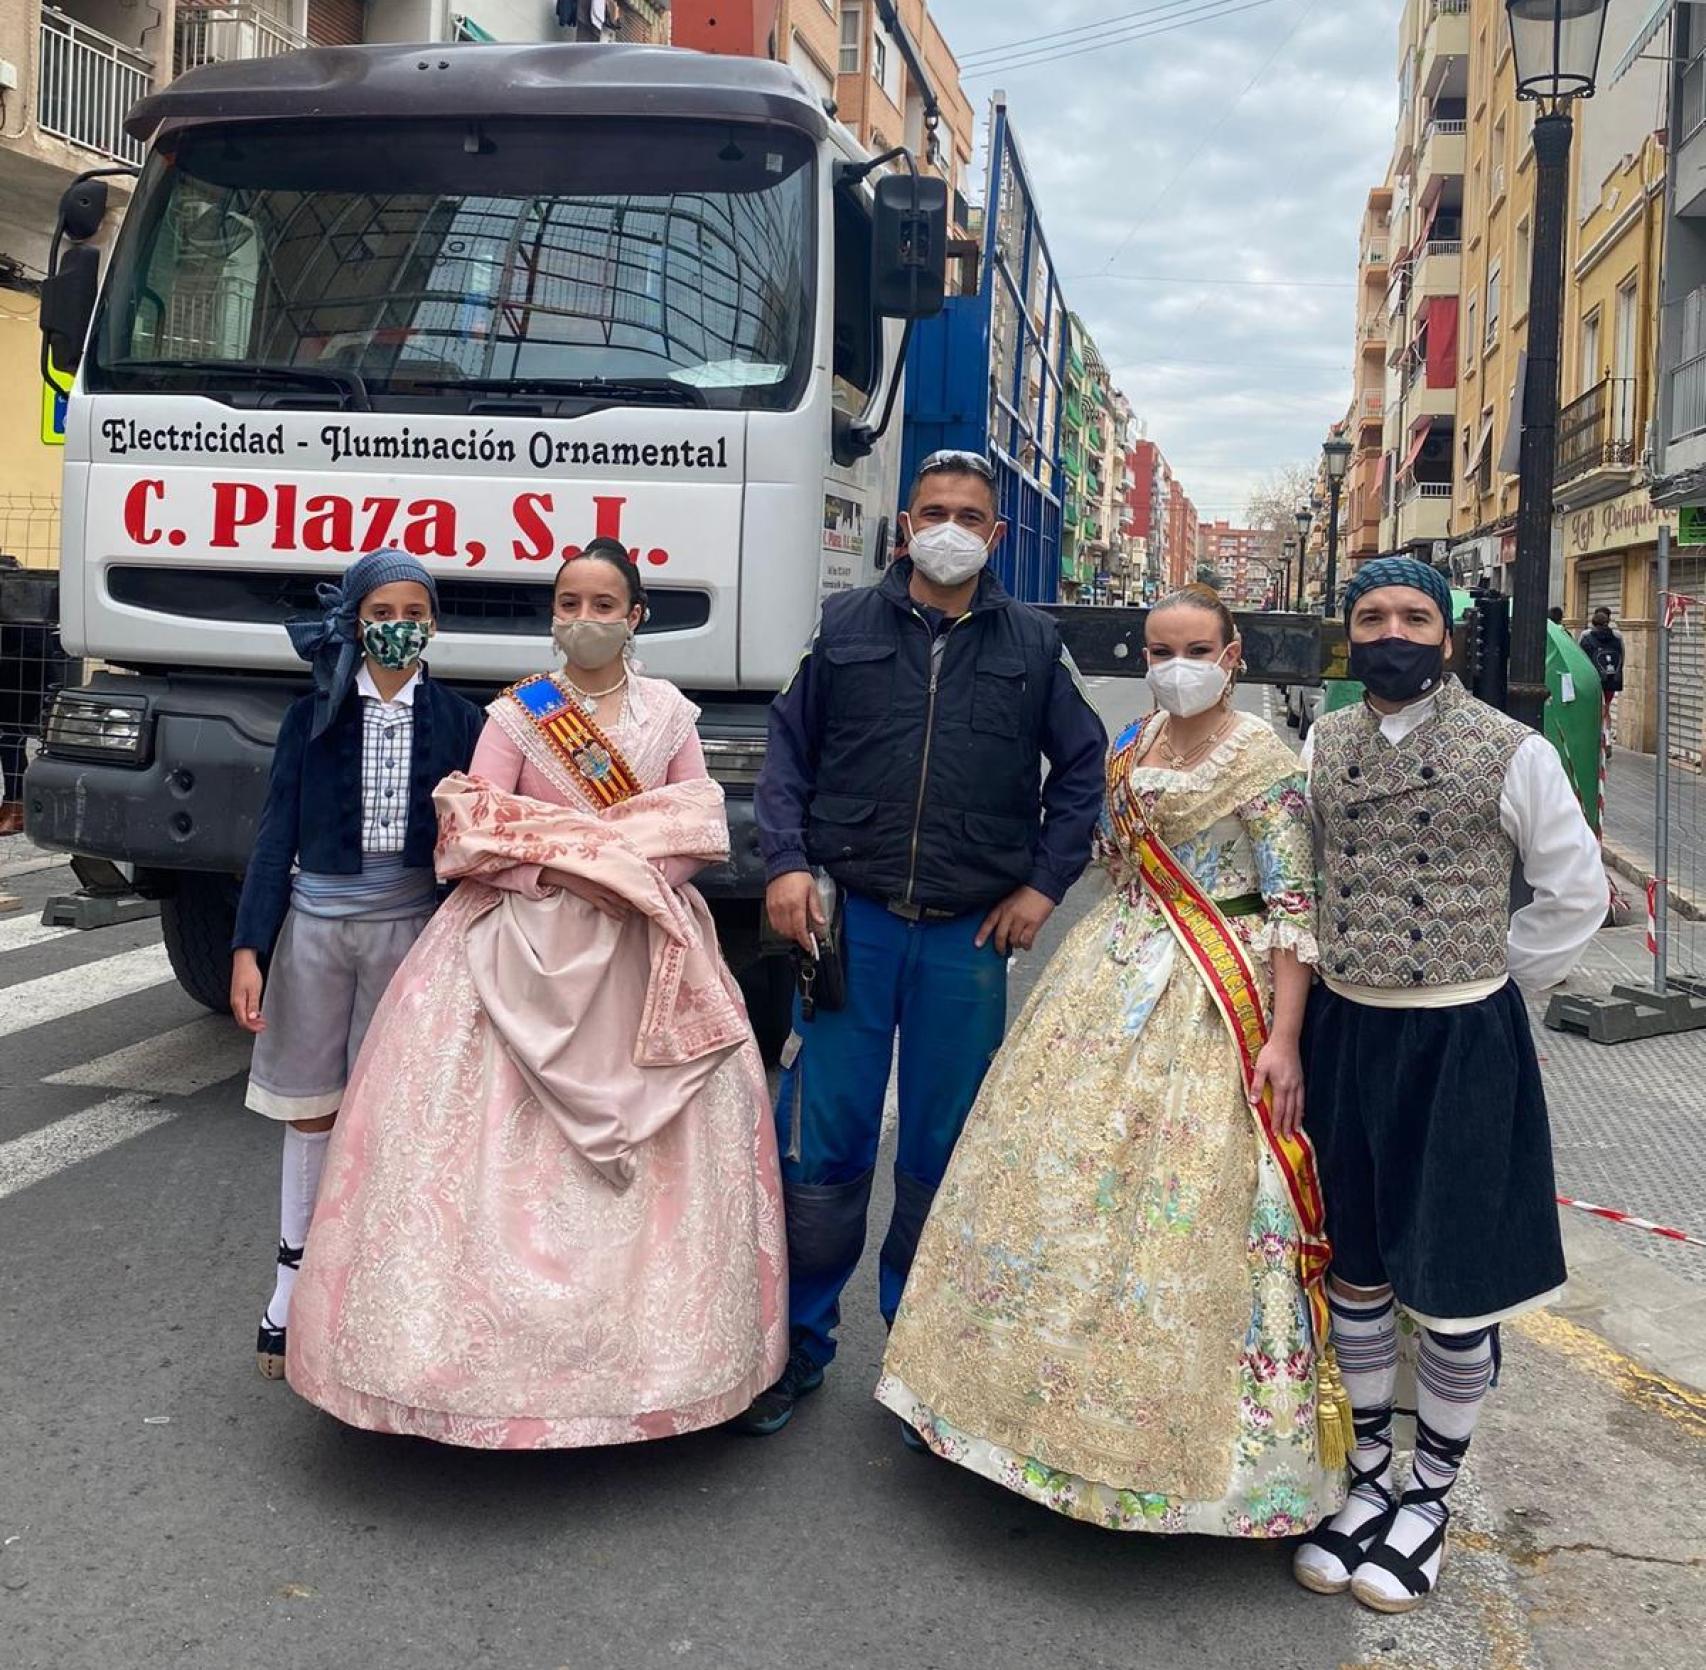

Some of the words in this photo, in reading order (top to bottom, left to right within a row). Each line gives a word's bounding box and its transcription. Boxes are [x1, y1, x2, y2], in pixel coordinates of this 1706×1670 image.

[102, 418, 285, 454] Electricidad
[320, 425, 516, 462] Iluminación
[529, 431, 728, 468] Ornamental
[124, 479, 187, 546] C.
[208, 481, 487, 567] Plaza,
